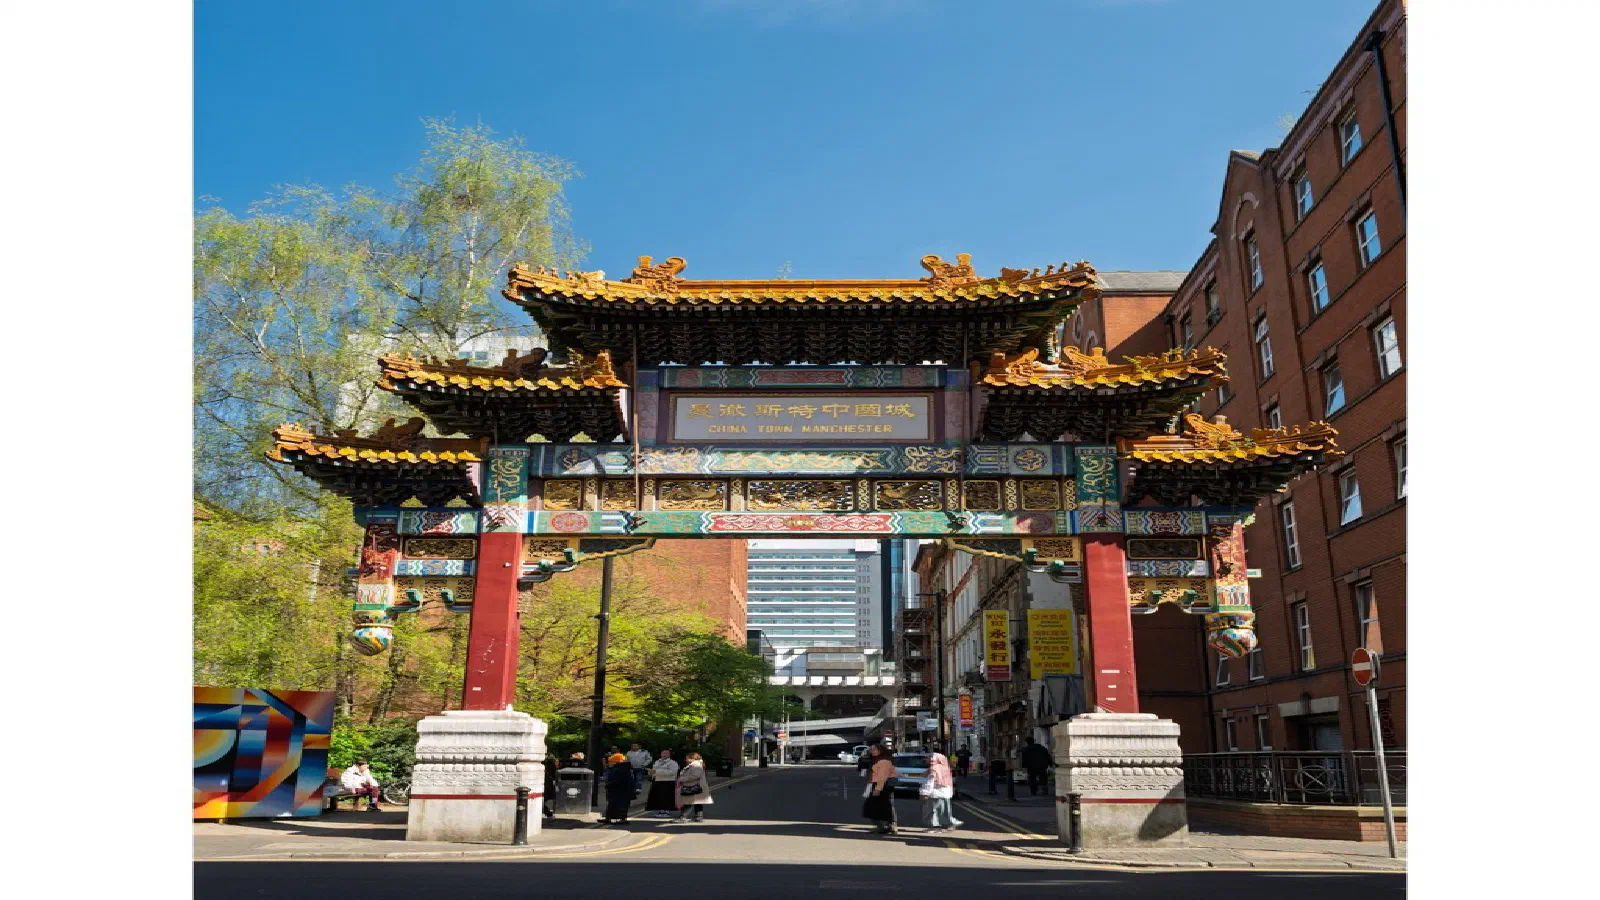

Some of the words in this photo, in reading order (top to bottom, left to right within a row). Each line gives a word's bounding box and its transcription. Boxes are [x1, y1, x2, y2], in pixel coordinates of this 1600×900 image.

[708, 425, 748, 433] CHINA
[757, 425, 793, 433] TOWN
[801, 425, 892, 433] MANCHESTER
